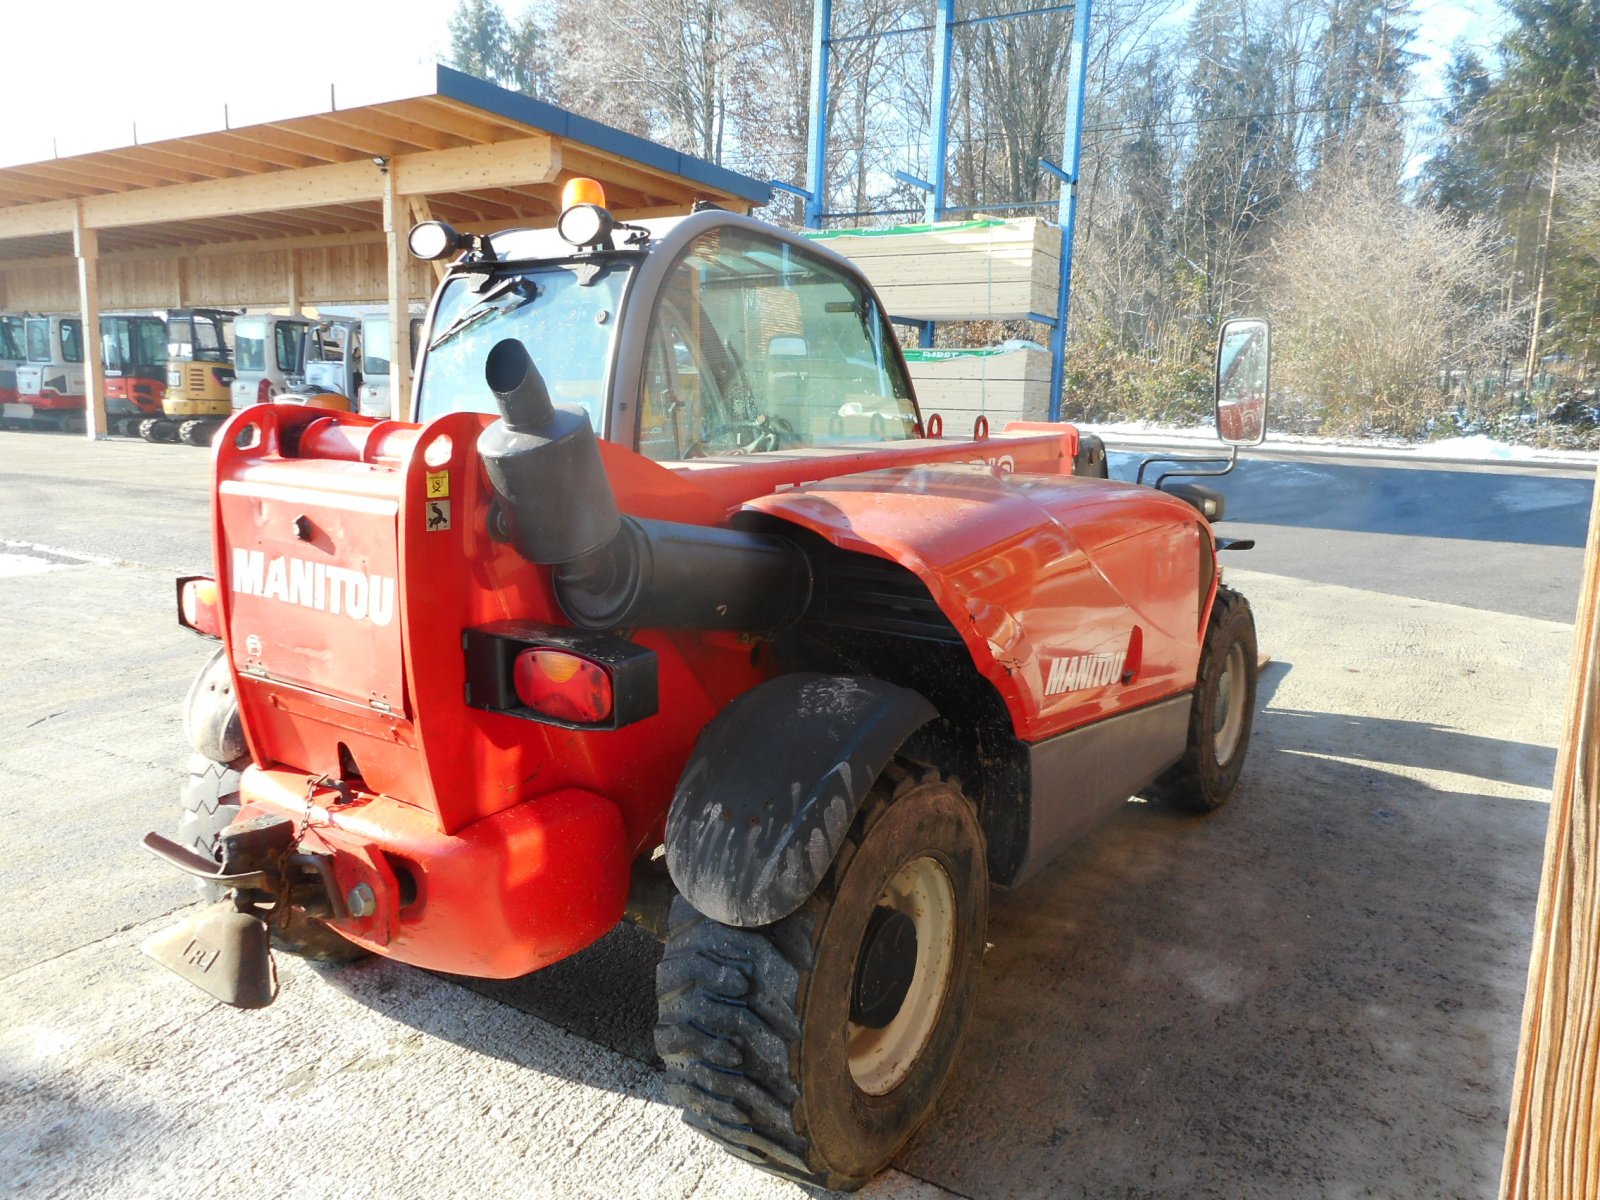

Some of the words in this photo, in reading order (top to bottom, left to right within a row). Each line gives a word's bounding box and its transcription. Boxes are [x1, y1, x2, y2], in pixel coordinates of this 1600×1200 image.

[922, 350, 960, 360] PABST
[232, 547, 395, 627] MANITOU
[1044, 651, 1127, 696] MANITOU
